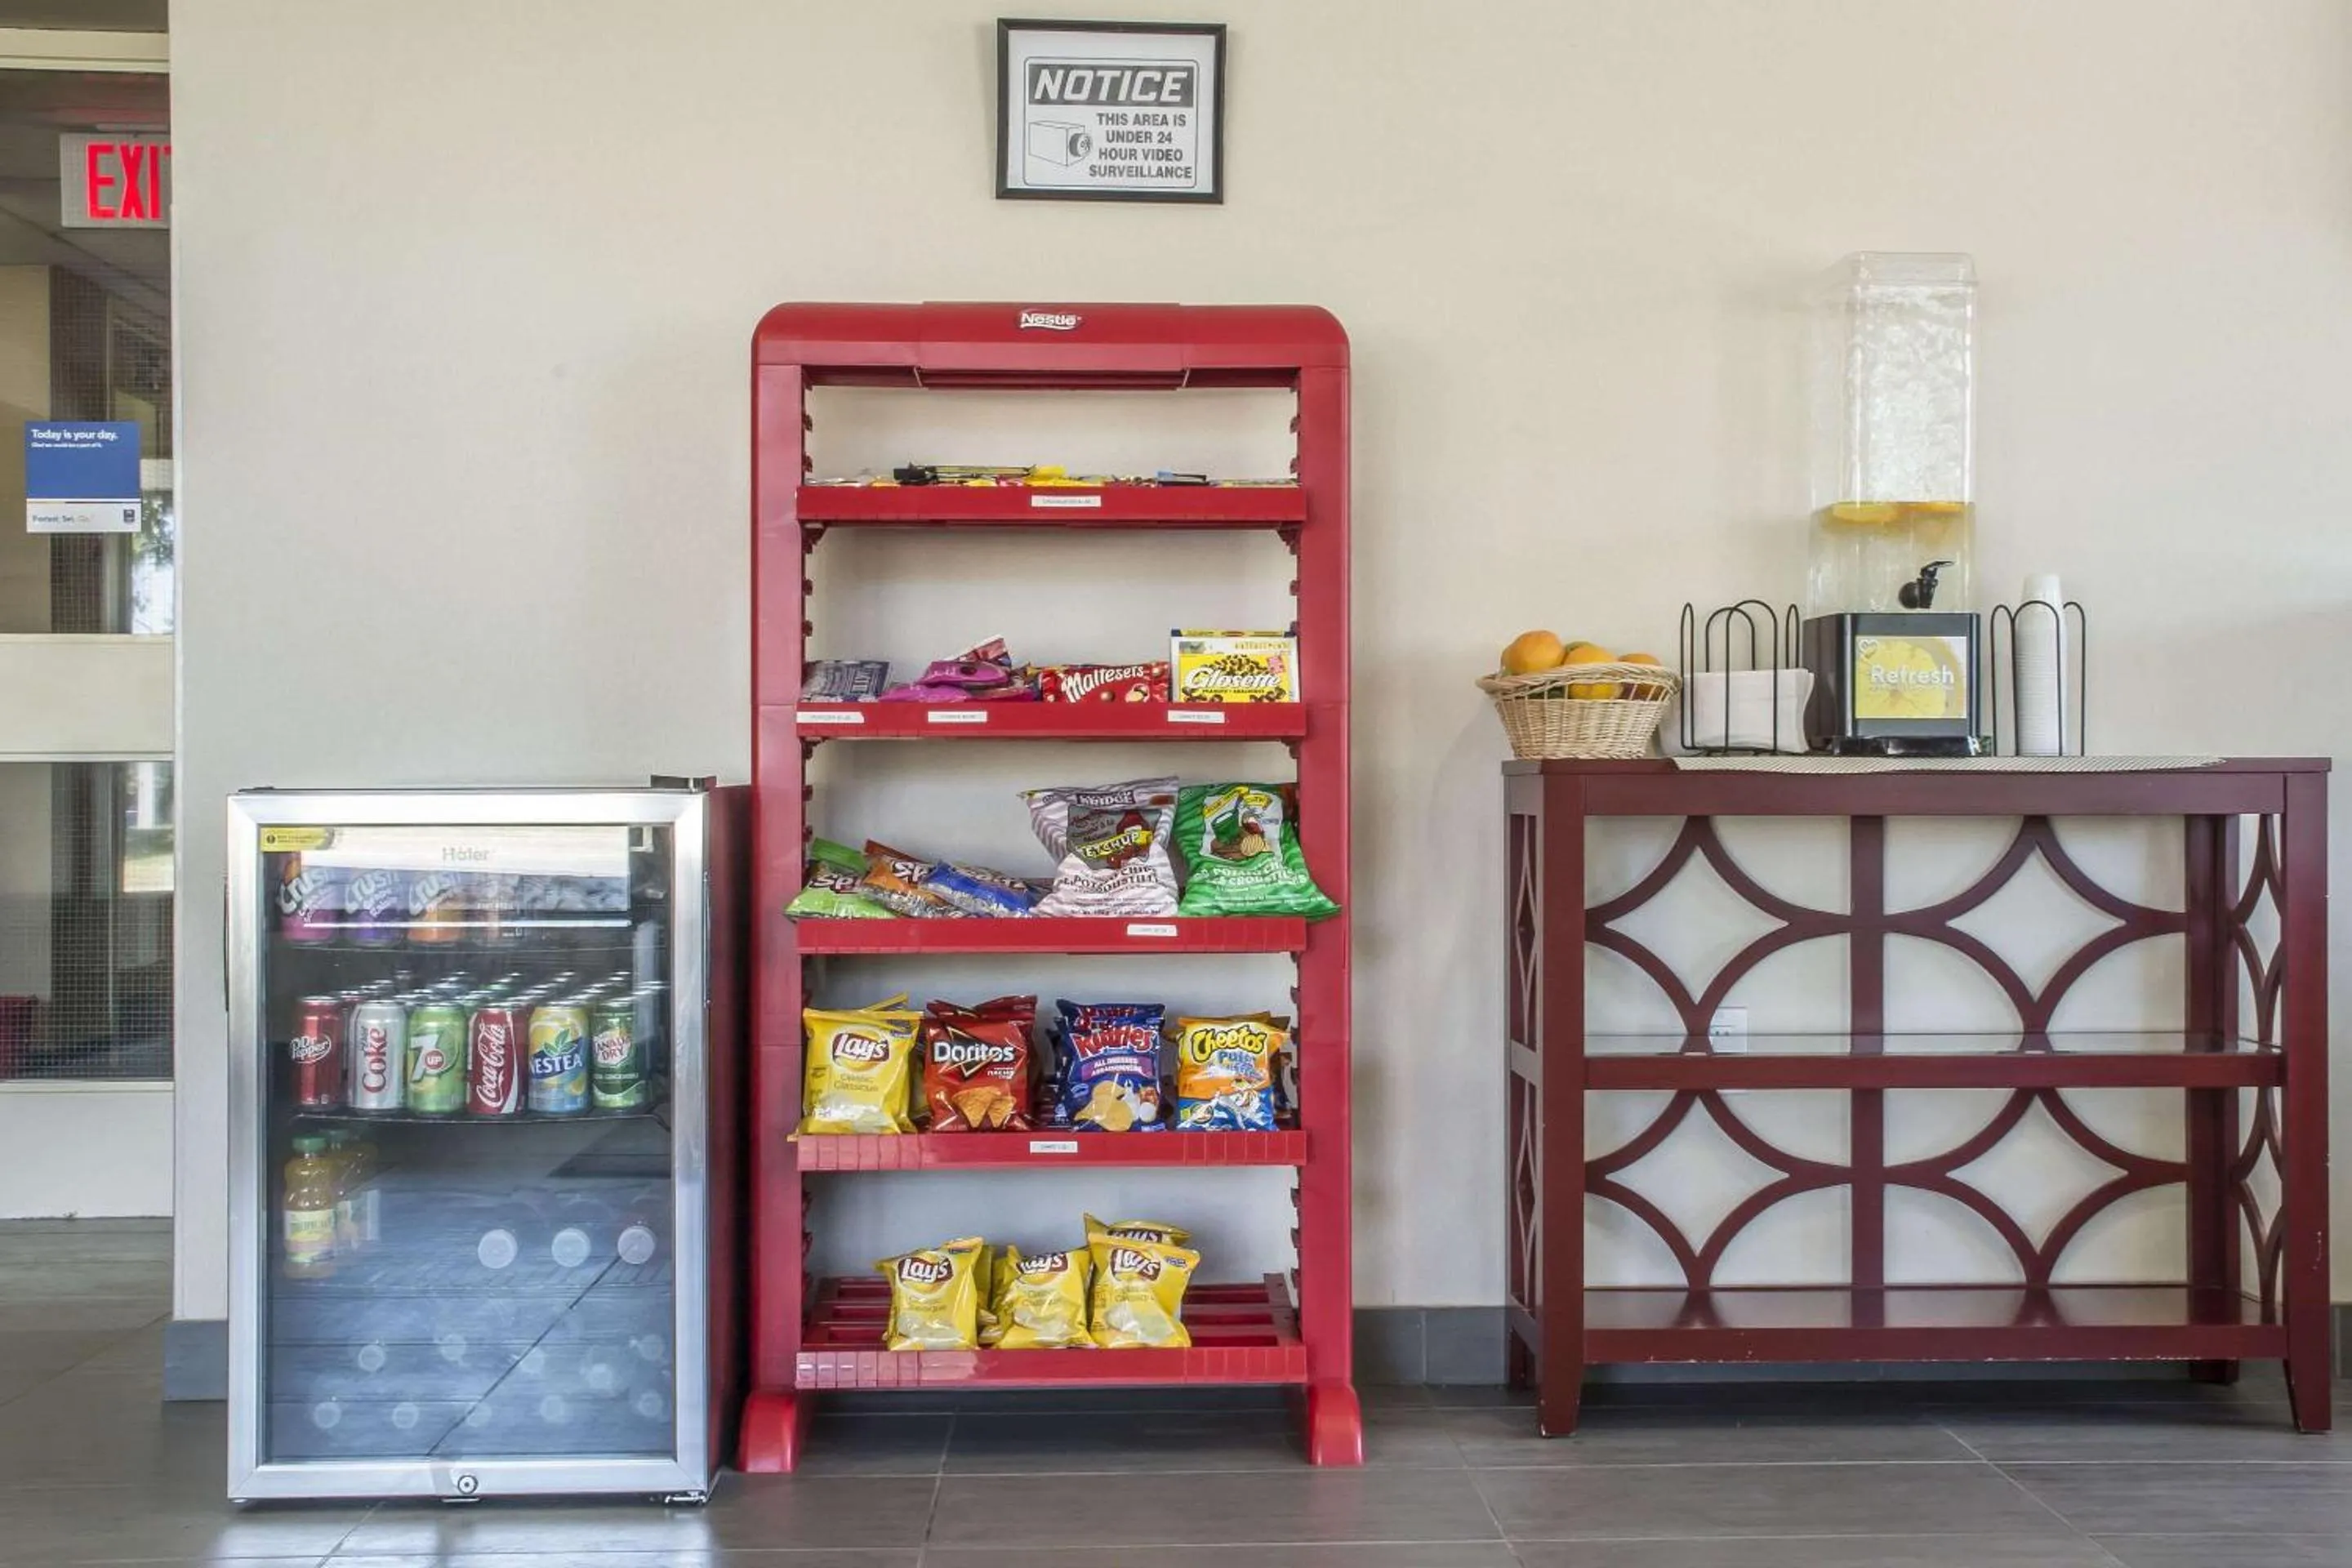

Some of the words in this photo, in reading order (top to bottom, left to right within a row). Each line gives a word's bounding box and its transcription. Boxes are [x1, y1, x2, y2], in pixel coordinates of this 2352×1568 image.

[1034, 69, 1187, 103] NOTICE
[1096, 113, 1128, 126] THIS
[1133, 114, 1169, 127] AREA
[1174, 114, 1187, 127] IS
[1106, 131, 1152, 144] UNDER
[1157, 131, 1173, 144] 24
[1098, 148, 1138, 161] HOUR
[1142, 149, 1183, 162] VIDEO
[87, 144, 172, 220] EXI
[1089, 165, 1192, 179] SURVEILLANCE
[31, 429, 62, 442] Today
[63, 429, 72, 439] is
[74, 432, 96, 442] your
[1061, 666, 1144, 703] Maltesers
[1870, 665, 1955, 684] Refresh
[933, 1041, 1015, 1062] Doritos
[1192, 1025, 1267, 1062] Cheetos
[362, 1027, 387, 1093] Coke
[476, 1019, 506, 1107] Coca-Cola
